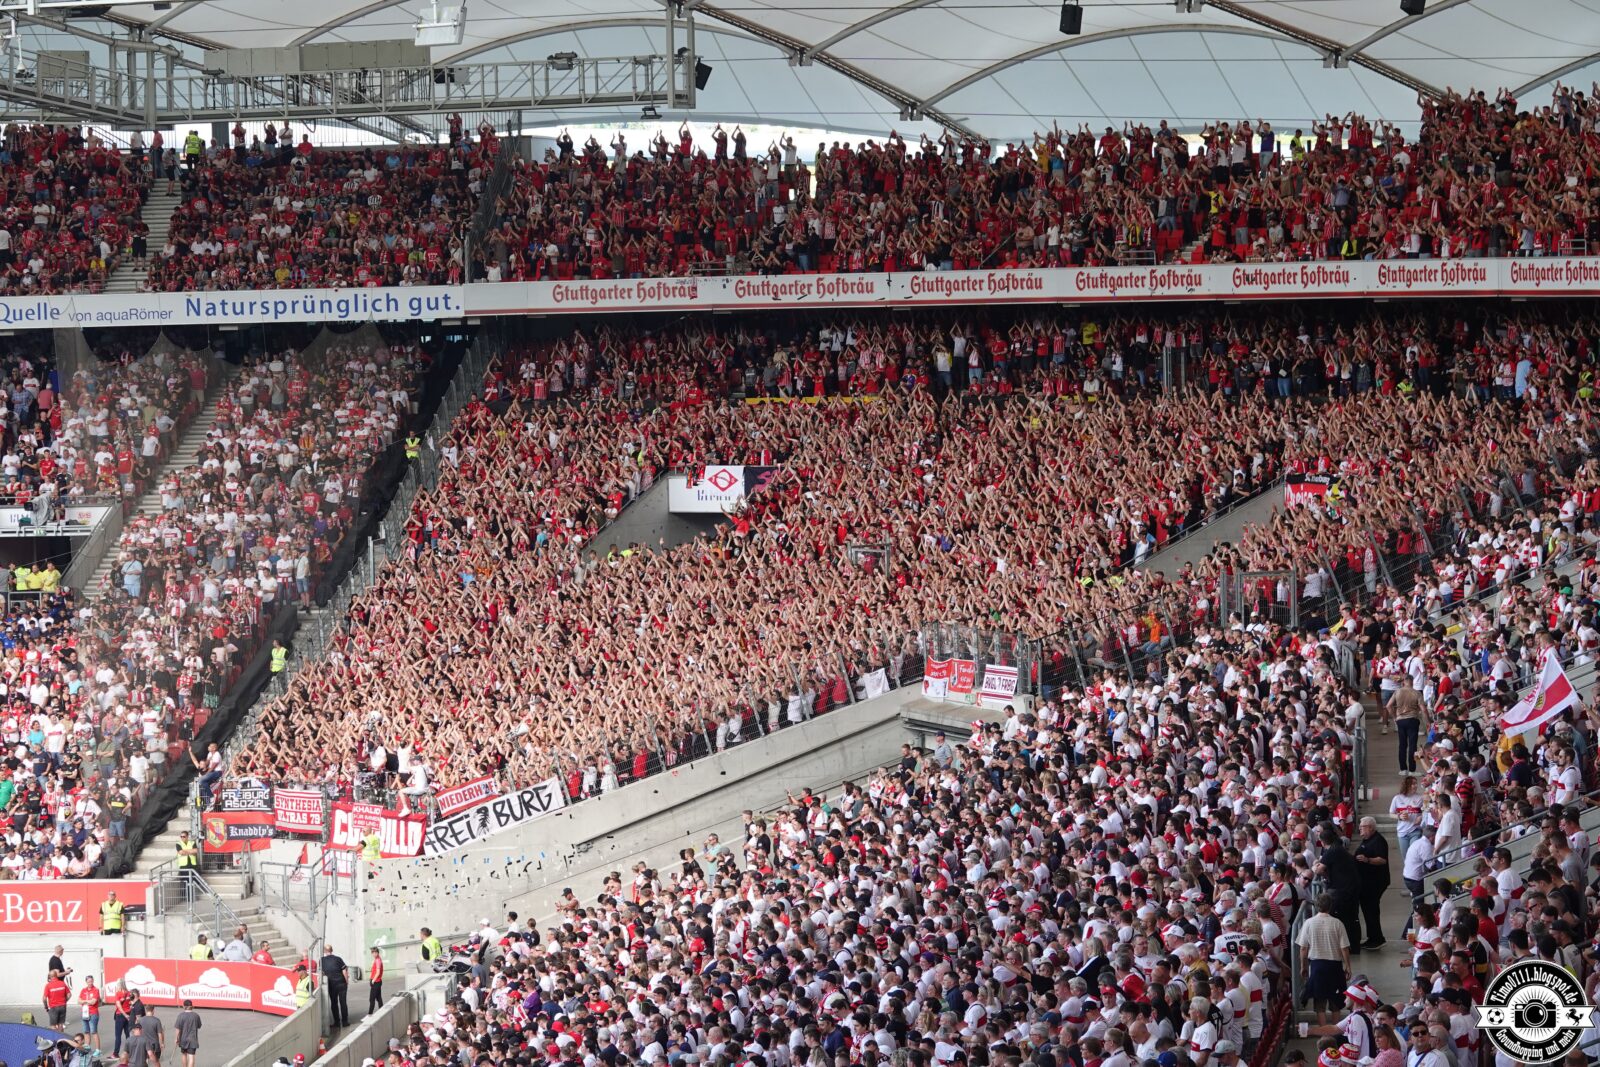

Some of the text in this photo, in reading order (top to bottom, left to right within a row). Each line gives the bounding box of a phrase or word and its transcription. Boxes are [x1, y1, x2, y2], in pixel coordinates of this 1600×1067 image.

[910, 272, 1043, 297] Stuttgarter Hofbräu
[1075, 268, 1202, 293] Stuttgarter Hofbräu
[1232, 264, 1349, 291] Stuttgarter Hofbräu
[1378, 261, 1487, 288] Stuttgarter Hofbräu
[1511, 261, 1563, 287] Stuttgarter
[552, 284, 632, 305] Stuttgarter
[735, 276, 875, 301] Stuttgarter Hofbräu
[69, 311, 92, 322] von
[96, 308, 174, 324] aquaRömer
[186, 293, 399, 319] Natursprünglich
[409, 293, 461, 316] gut.
[275, 795, 322, 811] SYNTHESIA
[438, 781, 495, 811] NIEDERHF
[493, 785, 553, 827] BURG
[277, 810, 308, 824] ULTRAS
[229, 825, 274, 839] Knaddly's
[181, 988, 249, 999] Schwarzwaldmilch
